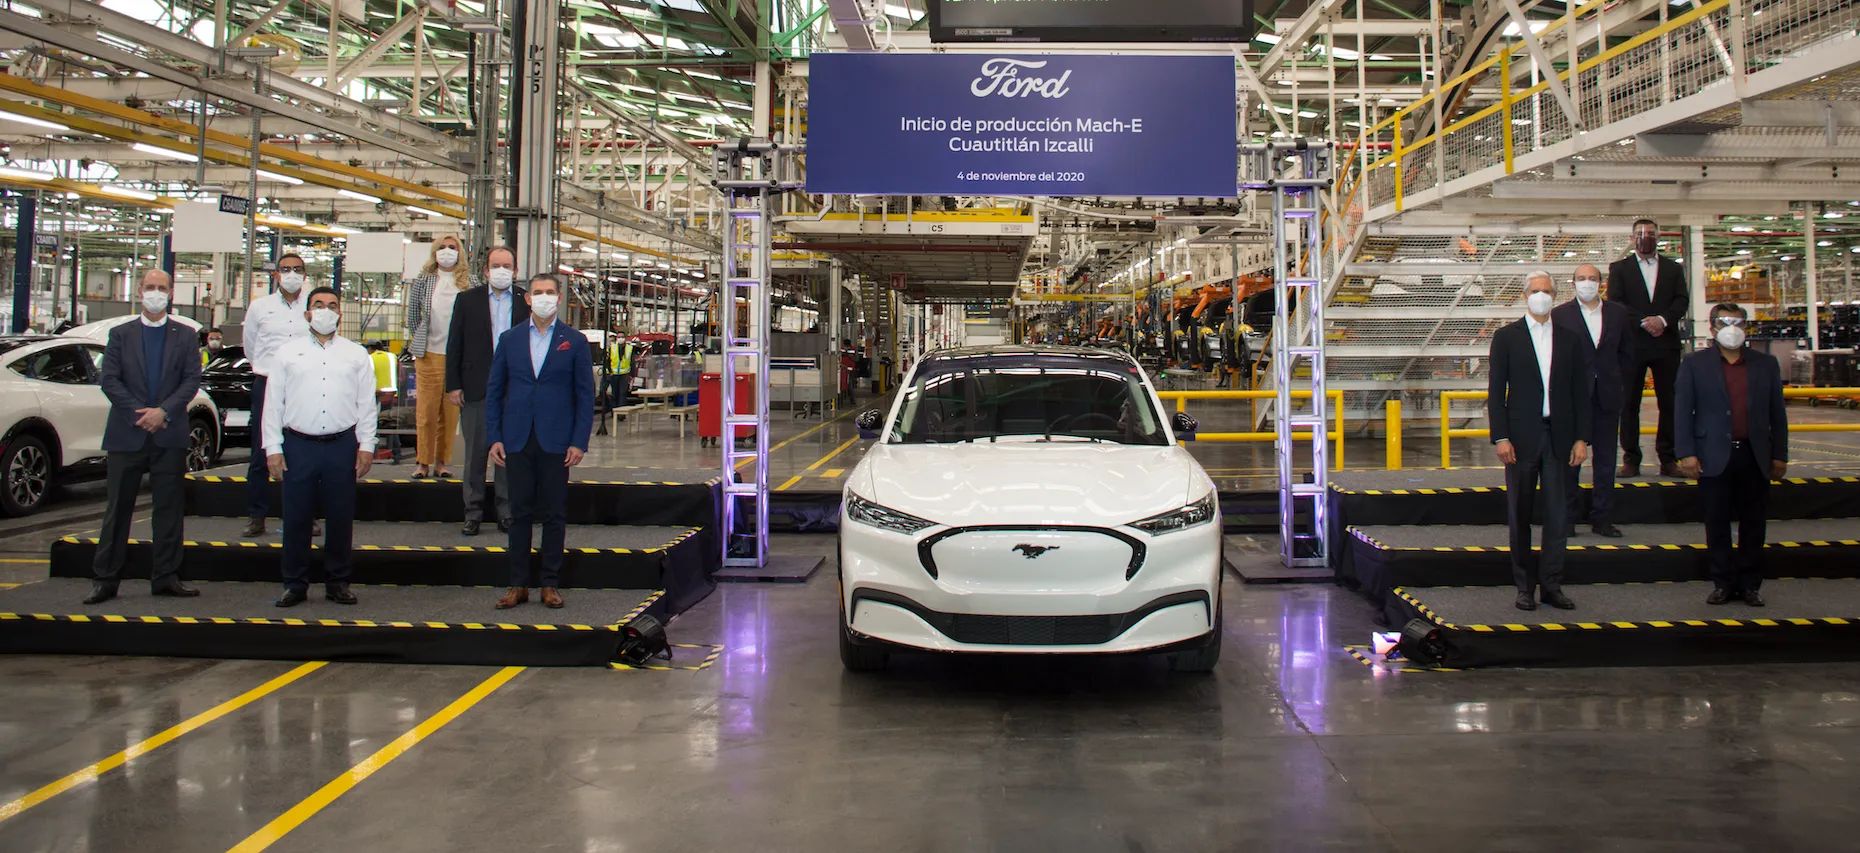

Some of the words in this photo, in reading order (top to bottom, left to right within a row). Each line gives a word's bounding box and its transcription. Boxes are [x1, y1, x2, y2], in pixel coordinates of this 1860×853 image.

[971, 58, 1072, 98] Ford
[902, 117, 946, 131] Inicio
[951, 117, 971, 131] de
[976, 117, 1072, 133] producción
[1077, 118, 1142, 132] Mach-E
[949, 137, 1039, 152] Cuautitlán
[1045, 138, 1093, 152] Izcalli
[957, 172, 964, 180] 4
[966, 171, 979, 180] de
[982, 172, 1036, 181] noviembre
[1038, 172, 1054, 181] del
[1057, 172, 1084, 181] 2020
[931, 224, 944, 233] C5
